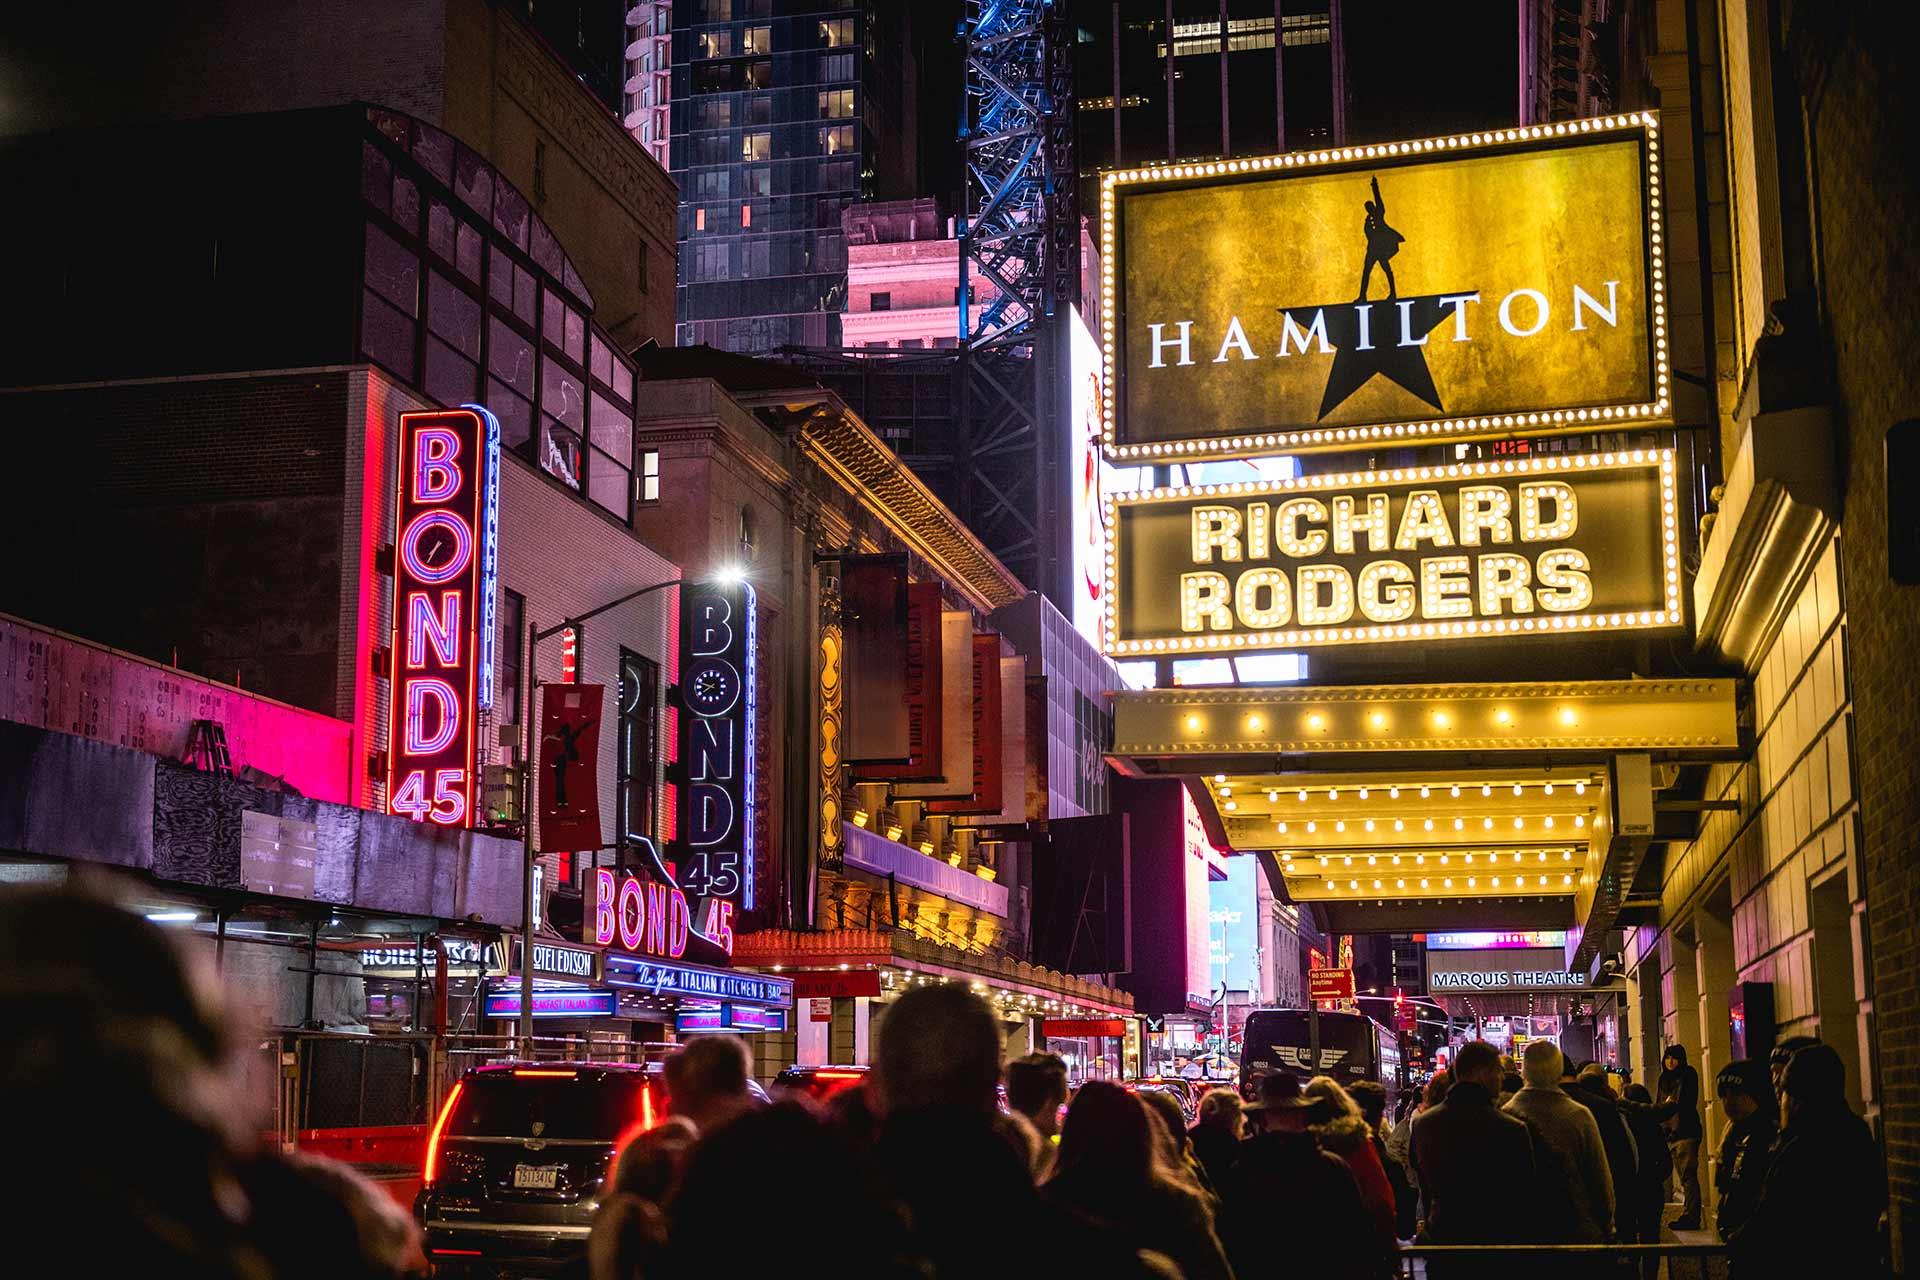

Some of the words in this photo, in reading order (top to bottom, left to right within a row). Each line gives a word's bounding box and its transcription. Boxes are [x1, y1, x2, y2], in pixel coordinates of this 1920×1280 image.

[1146, 280, 1621, 369] HAMILTON
[1190, 480, 1580, 564] RICHARD
[401, 427, 473, 756] BOND
[1179, 548, 1594, 633] RODGERS
[682, 597, 741, 846] BOND
[392, 769, 465, 823] 45
[683, 852, 740, 896] 45
[595, 867, 688, 958] BOND
[704, 898, 734, 957] 45
[533, 946, 557, 972] OTEL
[558, 950, 591, 976] EDISON
[680, 971, 718, 993] ITALIAN
[720, 980, 757, 997] KITCHEN
[767, 985, 783, 1000] BAR
[1320, 971, 1345, 979] STANDING
[1432, 971, 1509, 989] MARQUIS
[1512, 970, 1585, 986] THEATRE
